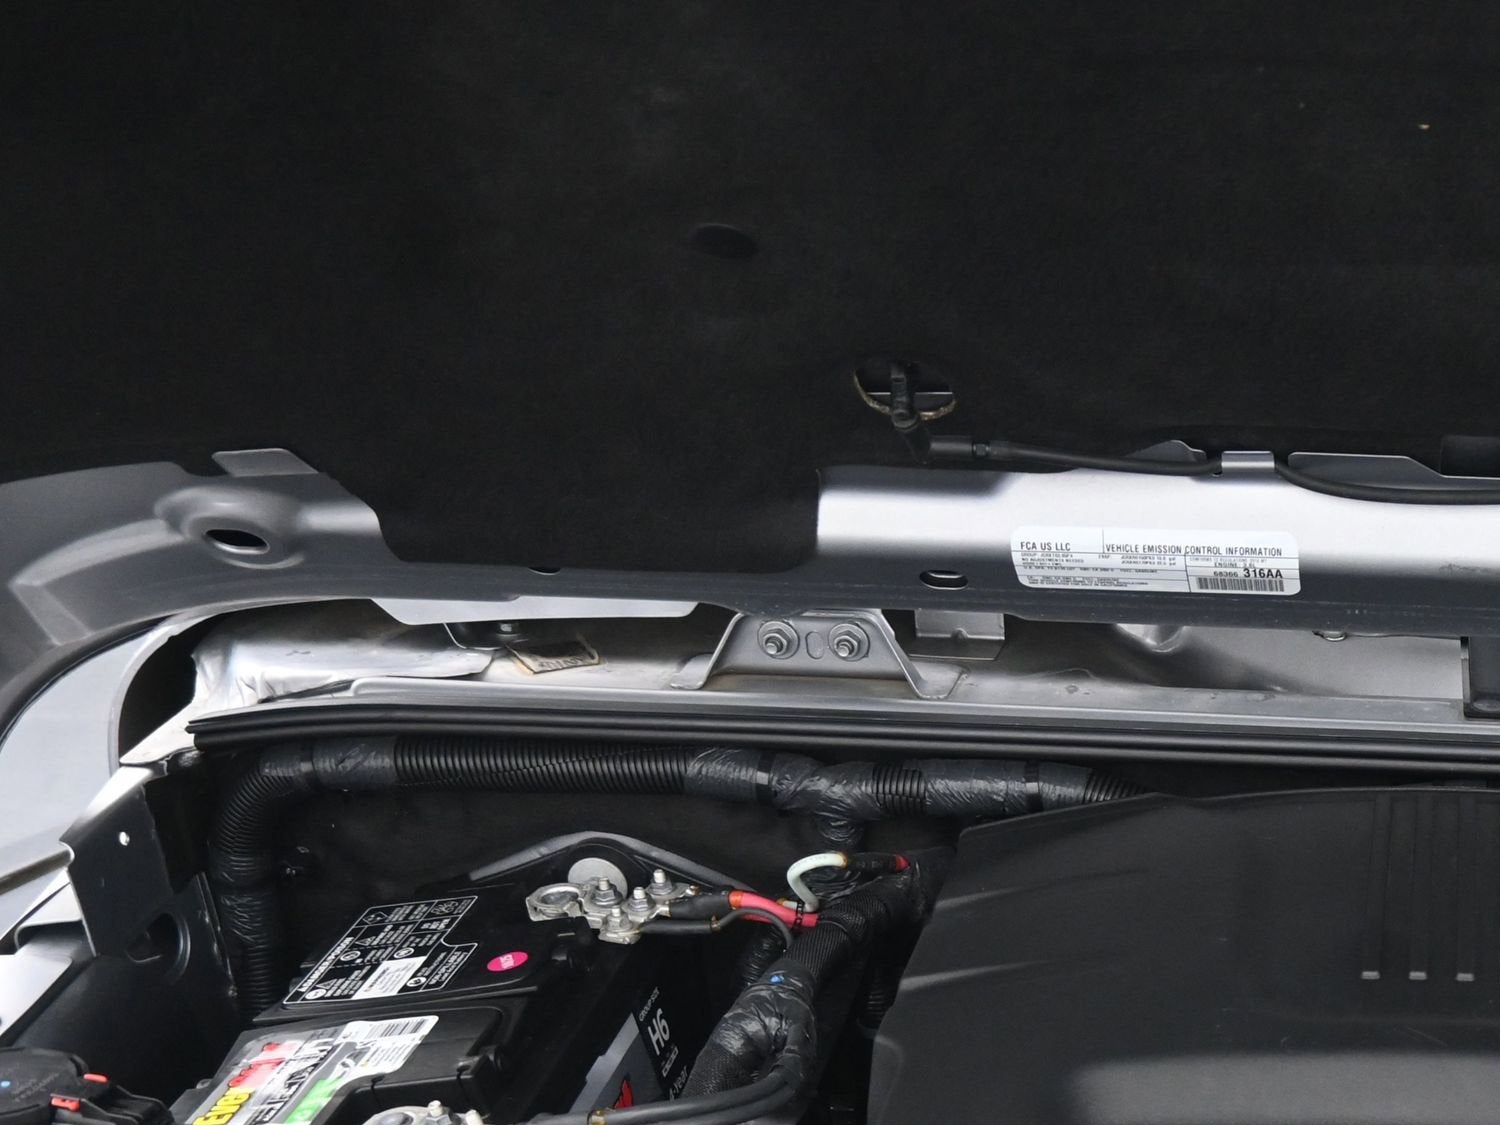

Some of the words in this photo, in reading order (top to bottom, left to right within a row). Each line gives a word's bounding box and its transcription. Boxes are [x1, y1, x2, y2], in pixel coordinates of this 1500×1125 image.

[1020, 541, 1037, 550] FCA
[1040, 542, 1052, 551] US
[1055, 543, 1071, 552] LLC
[1105, 544, 1140, 553] VEHICLE
[1142, 545, 1182, 554] EMISSION
[1184, 545, 1222, 555] CONTROL
[1225, 547, 1282, 556] INFORMATION
[1242, 568, 1283, 578] 316AA
[647, 1007, 670, 1056] H6
